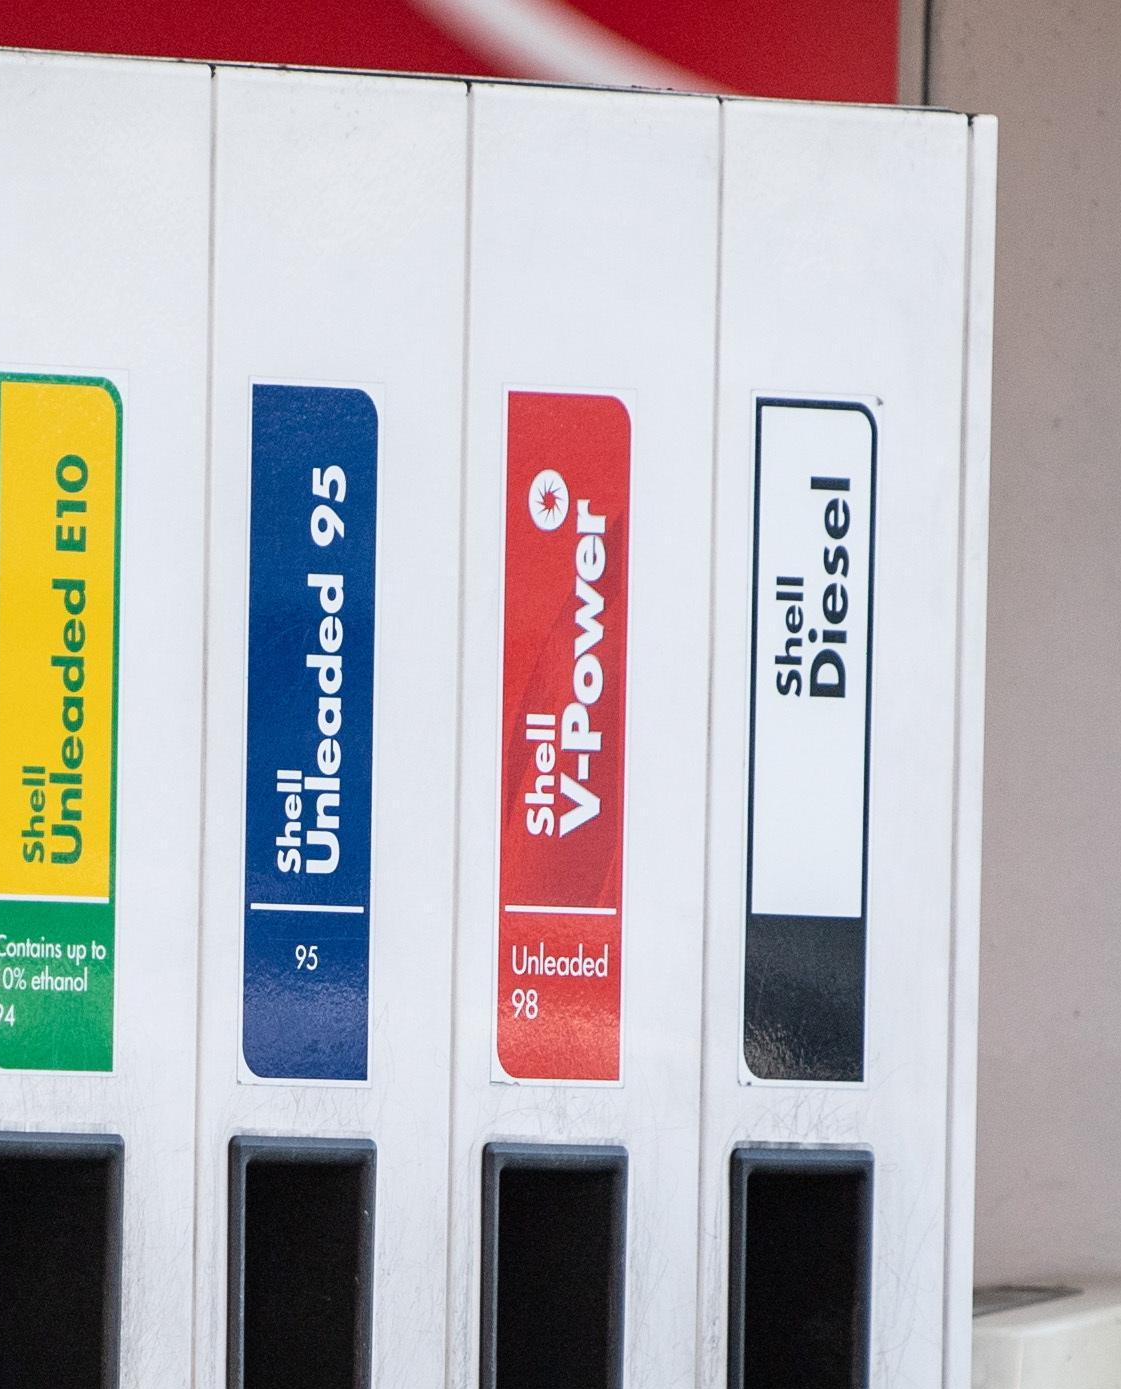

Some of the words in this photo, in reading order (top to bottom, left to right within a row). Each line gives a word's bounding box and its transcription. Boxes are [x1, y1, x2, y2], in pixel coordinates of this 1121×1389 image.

[55, 453, 89, 553] E10
[310, 465, 347, 547] 95
[775, 575, 804, 697] Shell
[809, 476, 851, 698] Diesel
[559, 499, 606, 838] V-Power
[49, 578, 86, 865] Unleaded
[305, 573, 344, 875] Unleaded
[22, 766, 46, 864] Shell
[275, 769, 302, 874] Shell
[525, 713, 556, 837] Shell
[31, 967, 88, 992] ethanol
[67, 943, 86, 964] up
[91, 941, 107, 961] to
[295, 945, 318, 971] 95
[511, 943, 609, 978] Unleaded
[511, 989, 538, 1020] 98
